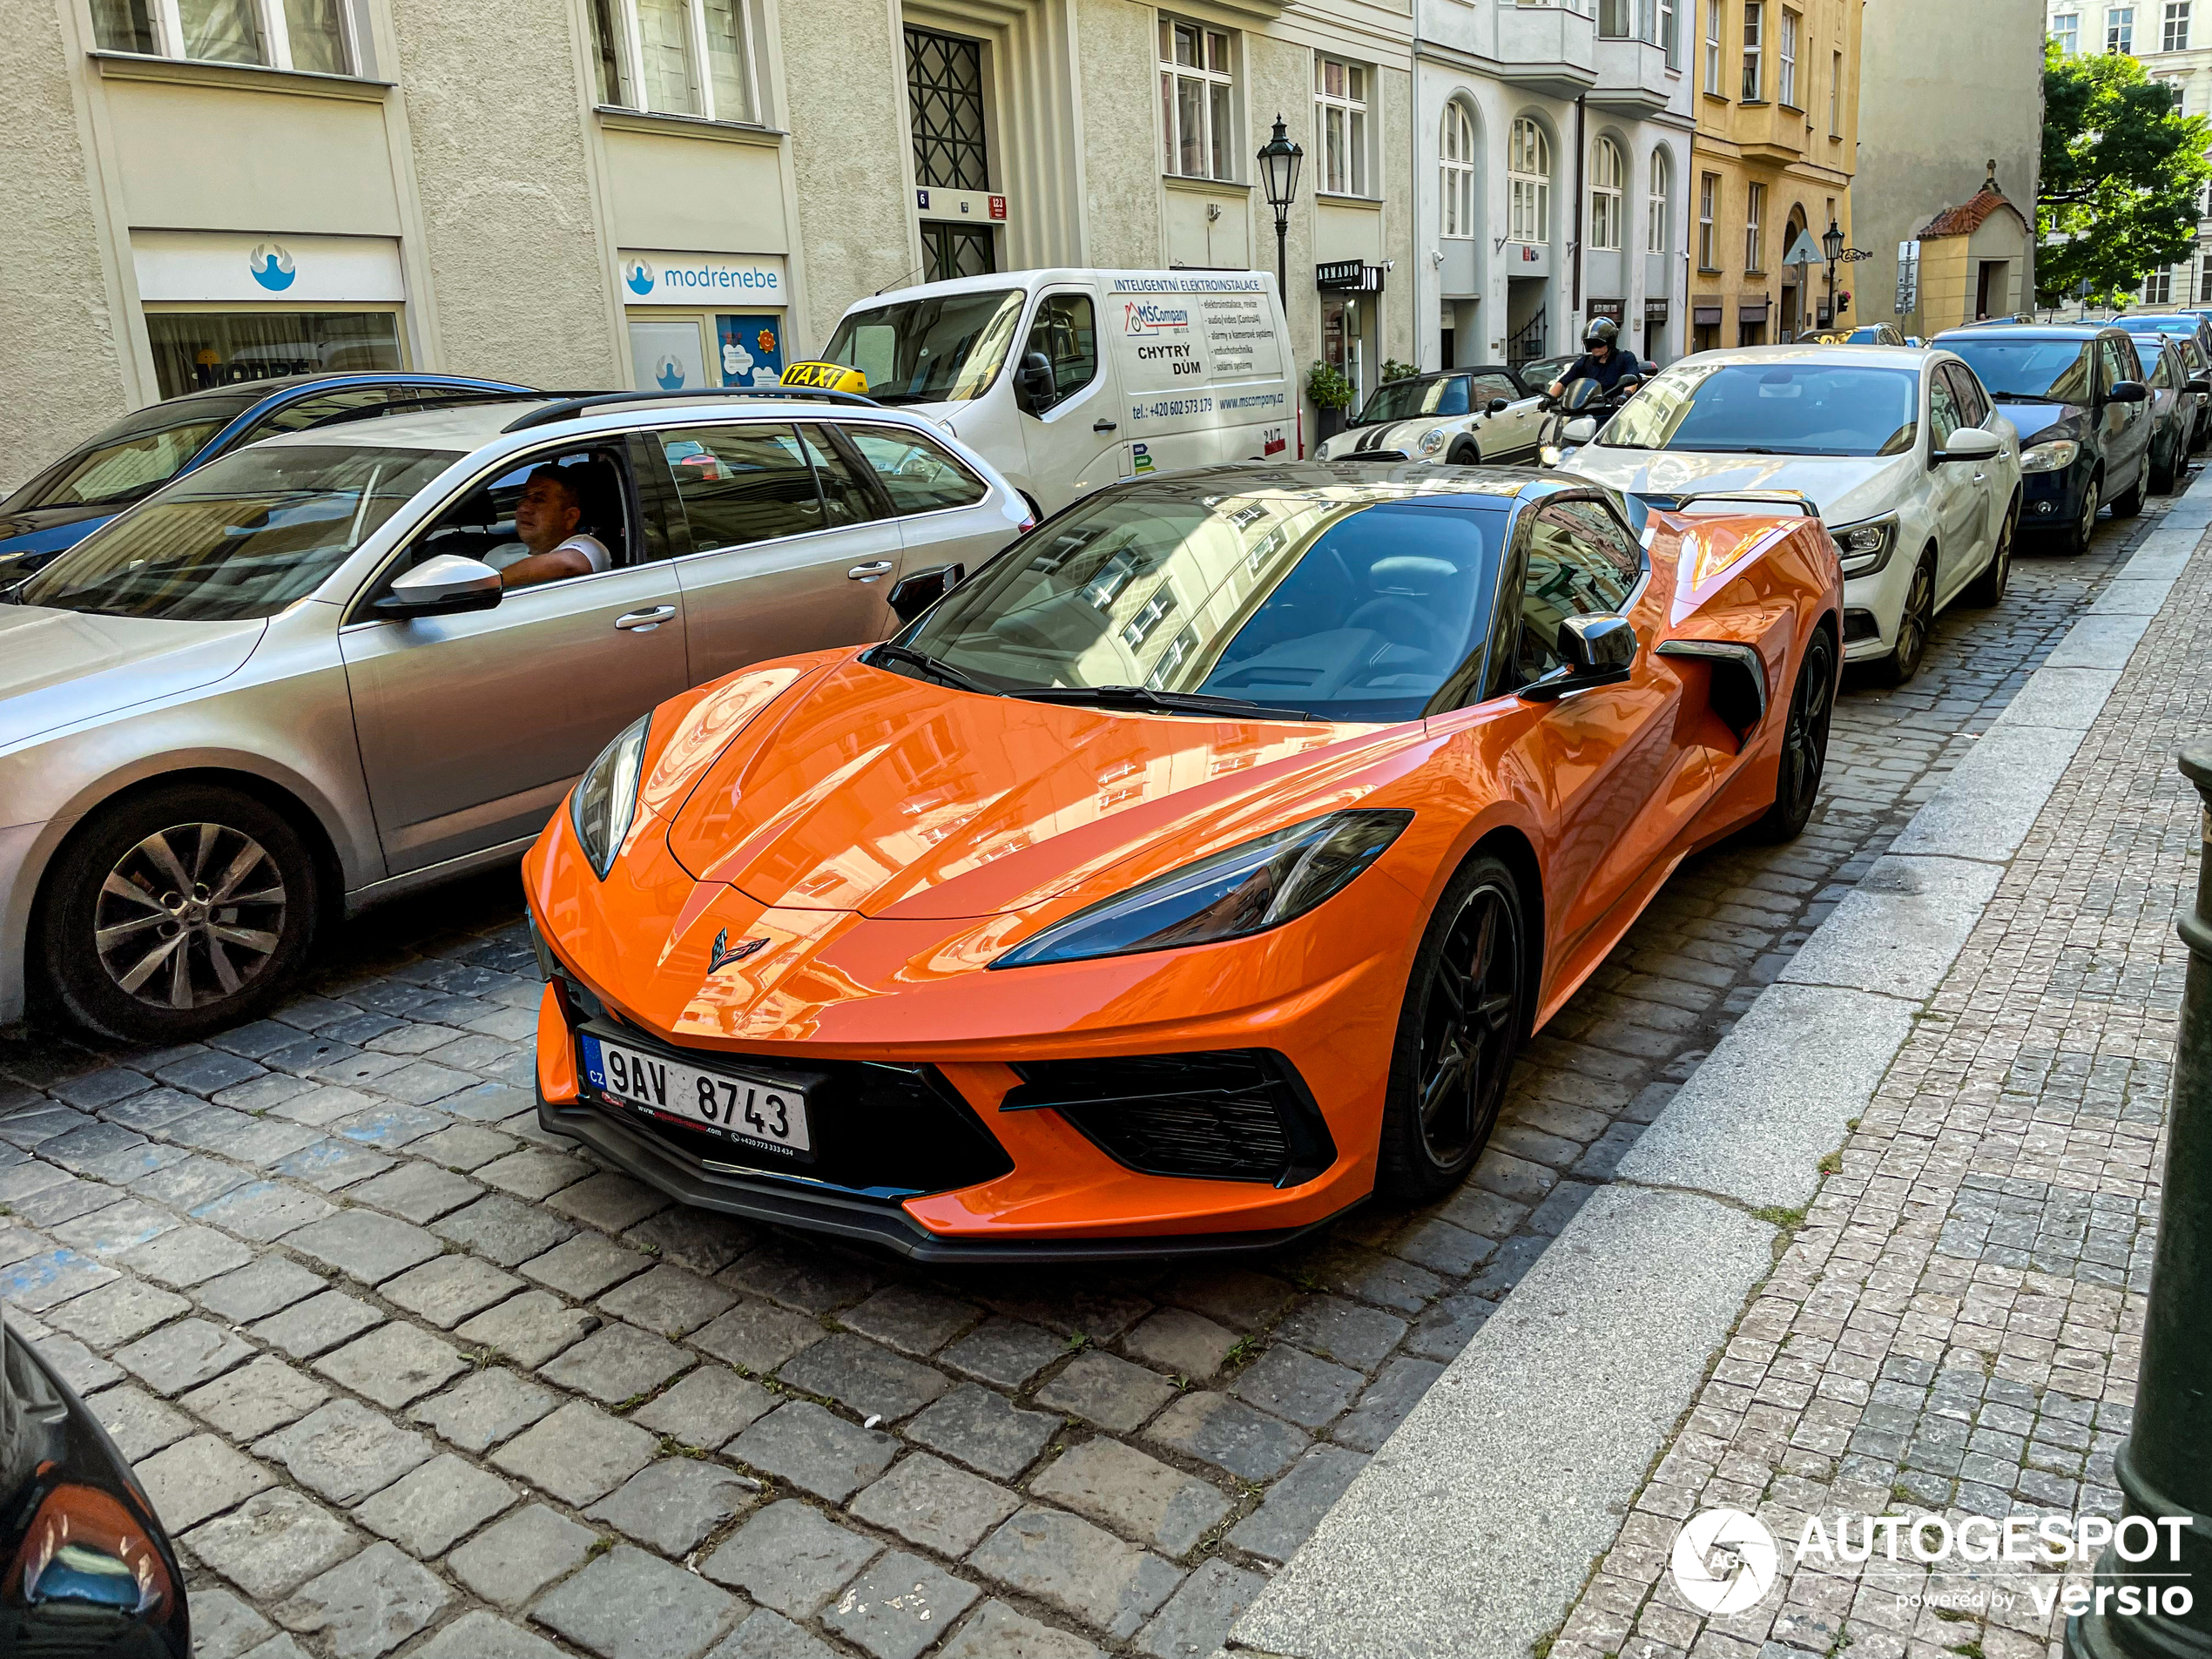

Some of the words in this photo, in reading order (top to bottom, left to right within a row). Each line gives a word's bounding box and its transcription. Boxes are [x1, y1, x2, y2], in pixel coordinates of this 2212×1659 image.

[920, 193, 926, 205] 6
[992, 198, 1003, 208] 123
[664, 265, 778, 289] modrénebe
[1318, 264, 1359, 280] ARMADIO
[1114, 278, 1180, 291] INTELIGENTNÍ
[1181, 280, 1260, 291] ELEKTROINSTALACE
[1137, 300, 1188, 325] MŠCompany
[1232, 329, 1256, 339] kamerové
[1256, 328, 1274, 340] systémy
[1138, 341, 1190, 360] CHYTRÝ
[1214, 345, 1253, 355] vzduchotechnika
[1172, 359, 1202, 375] DŮM
[787, 365, 841, 388] TAXI
[1133, 403, 1149, 420] tel.:
[1150, 401, 1169, 417] +420
[1170, 400, 1184, 415] 602
[1185, 399, 1198, 414] 573
[1200, 397, 1212, 413] 179
[1219, 393, 1284, 410] www.mscompany.cz
[1264, 428, 1280, 444] 24/7
[590, 1069, 604, 1085] CZ
[609, 1050, 666, 1106] 9AV
[697, 1076, 789, 1138] 8743
[740, 1137, 756, 1146] +420
[757, 1141, 768, 1150] 773
[769, 1144, 780, 1153] 333
[781, 1148, 793, 1157] 434
